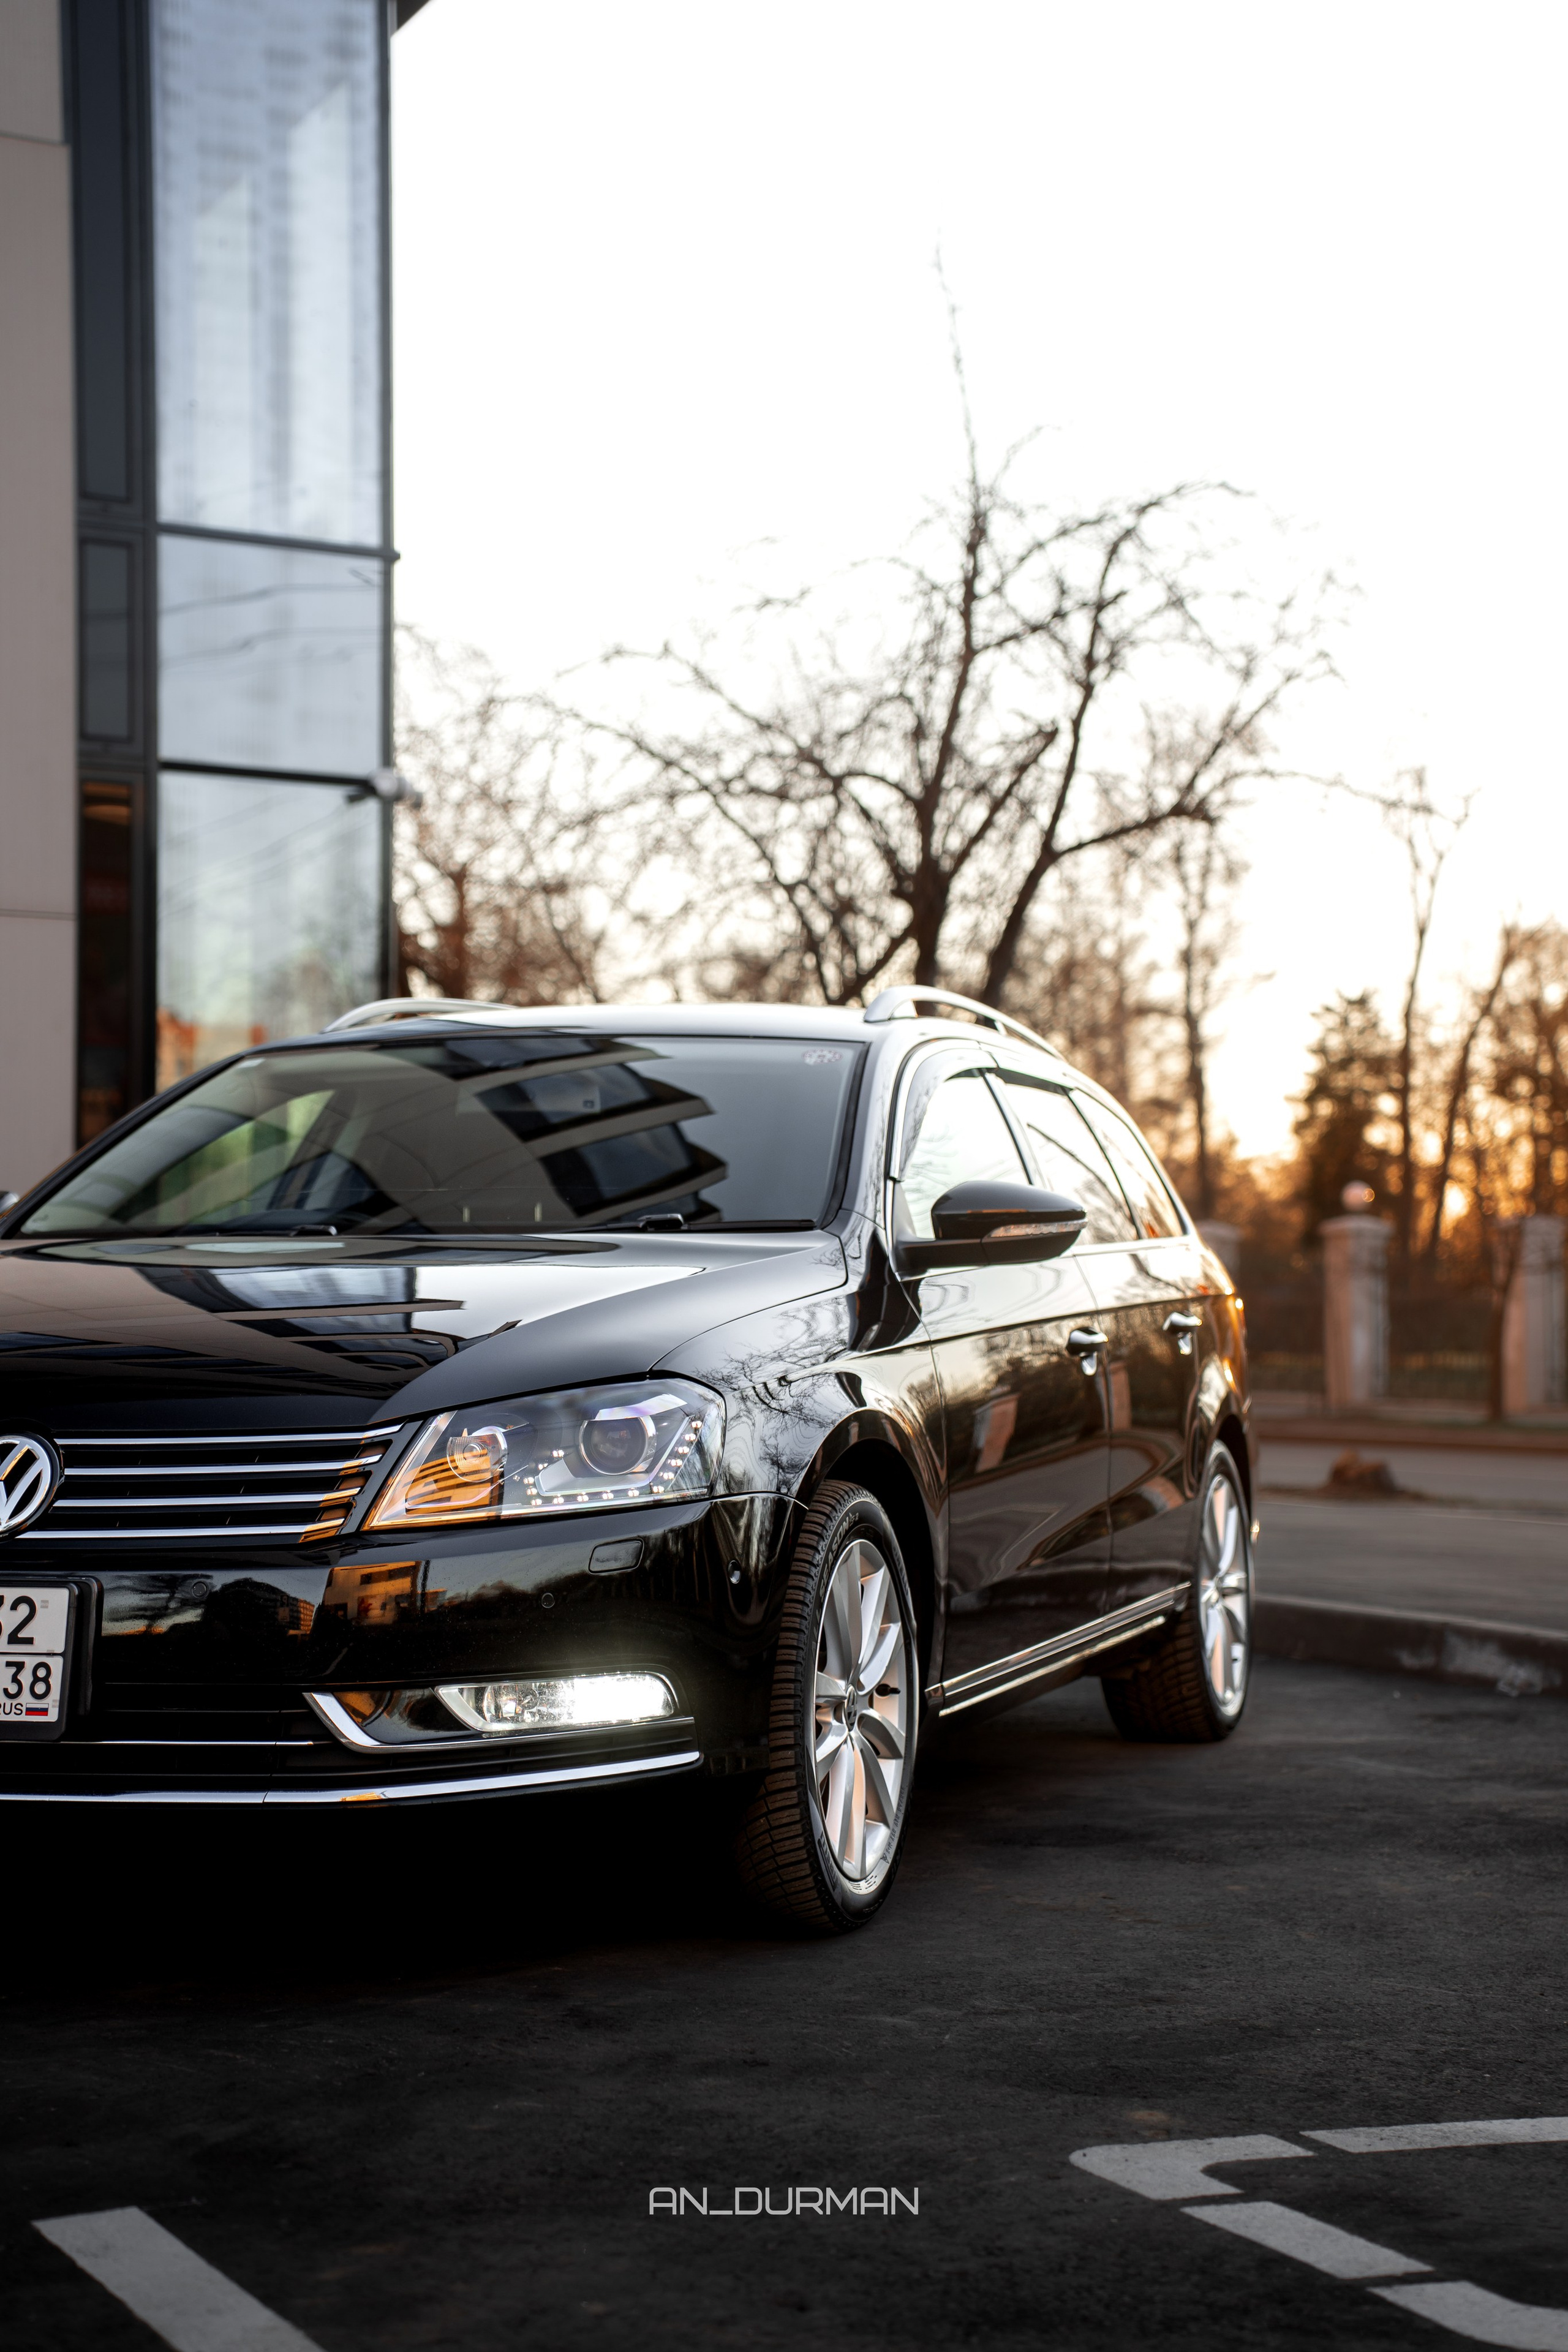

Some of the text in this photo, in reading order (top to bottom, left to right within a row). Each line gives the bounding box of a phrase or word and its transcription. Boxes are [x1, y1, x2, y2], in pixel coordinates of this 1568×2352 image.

[820, 1516, 850, 1602] SEASON
[0, 1595, 37, 1645] 2
[3, 1661, 51, 1700] 38
[0, 1702, 23, 1716] US
